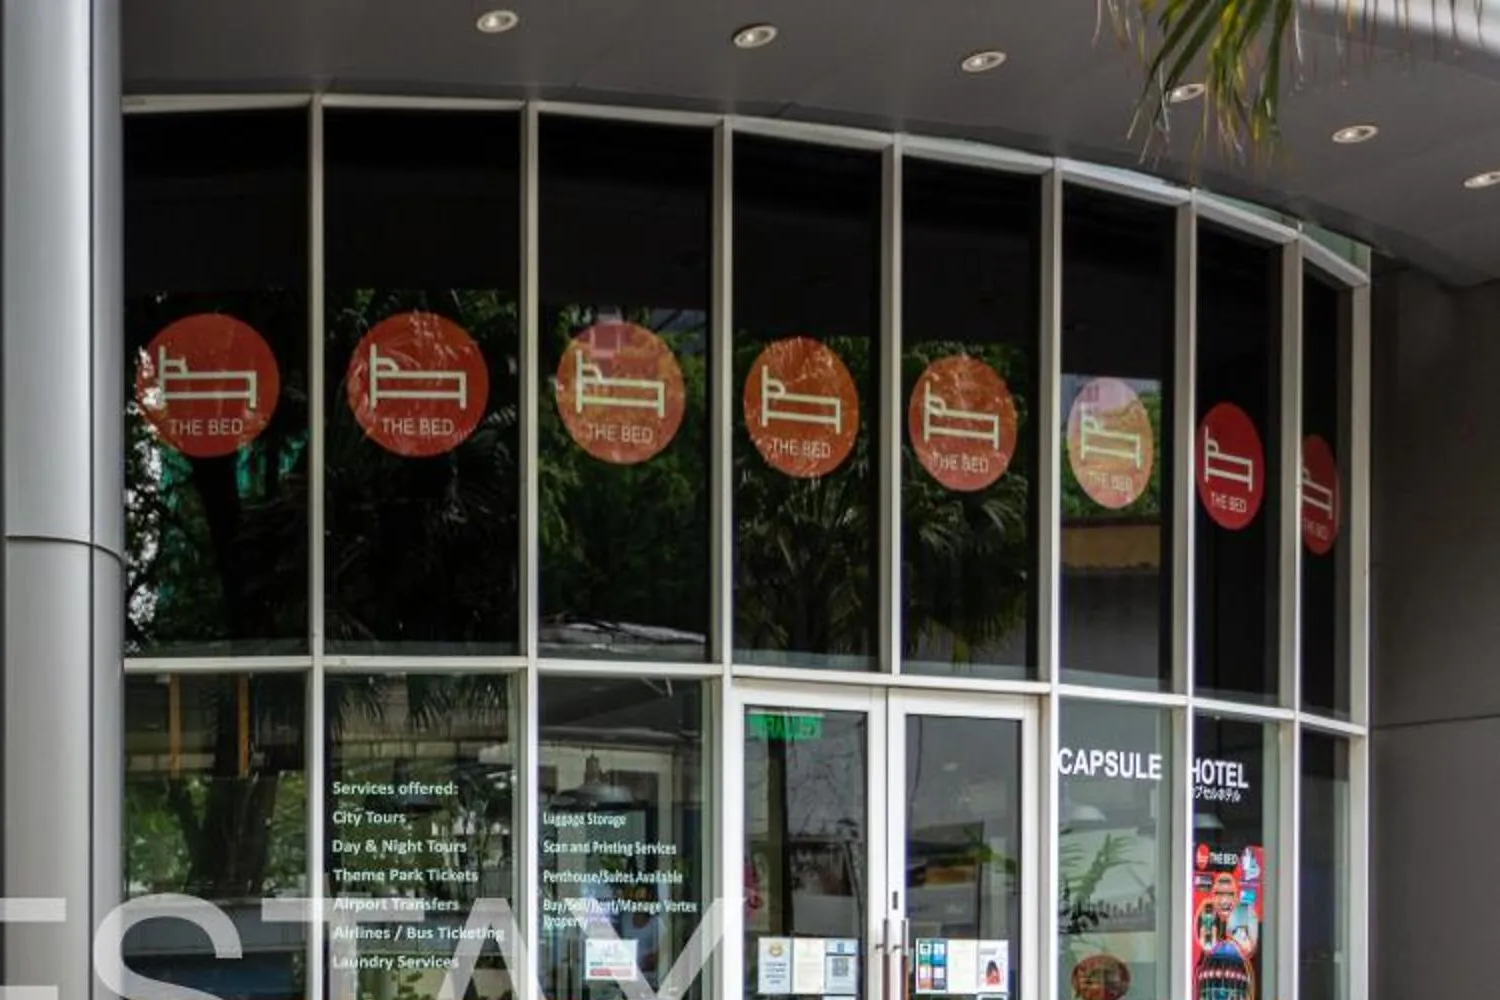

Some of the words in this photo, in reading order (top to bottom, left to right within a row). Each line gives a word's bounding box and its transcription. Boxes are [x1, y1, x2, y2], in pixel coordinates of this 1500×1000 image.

[169, 419, 202, 436] THE
[208, 418, 244, 436] BED
[381, 417, 414, 435] THE
[419, 418, 454, 437] BED
[585, 424, 617, 442] THE
[620, 425, 654, 444] BED
[771, 438, 795, 457] THE
[802, 440, 831, 459] BED
[932, 450, 958, 470] THE
[961, 453, 990, 473] BED
[1210, 491, 1226, 510] THE
[1228, 496, 1247, 513] BED
[1058, 748, 1162, 780] CAPSULE
[1191, 758, 1249, 789] HOTEL
[332, 781, 395, 795] Services
[398, 781, 459, 796] offered:
[332, 811, 362, 826] City
[365, 811, 407, 824] Tours
[543, 812, 585, 827] Luggage
[587, 812, 627, 828] Storage
[332, 839, 361, 854] Day
[365, 840, 377, 853] &
[382, 839, 423, 854] Night
[426, 840, 467, 853] Tours
[543, 841, 568, 854] Scan
[569, 842, 590, 853] and
[592, 842, 633, 857] Printing
[635, 842, 677, 855] Services
[333, 869, 386, 882] Theme
[389, 869, 424, 882] Park
[428, 868, 479, 882] Tickets
[635, 871, 683, 883] Available
[334, 898, 388, 913] Airport
[392, 897, 460, 911] Transfers
[664, 901, 698, 913] Vortex
[333, 926, 391, 939] Airlines
[394, 926, 403, 941] /
[407, 927, 434, 939] Bus
[438, 926, 505, 942] Ticketing
[333, 955, 394, 971] Laundry
[397, 955, 460, 969] Services
